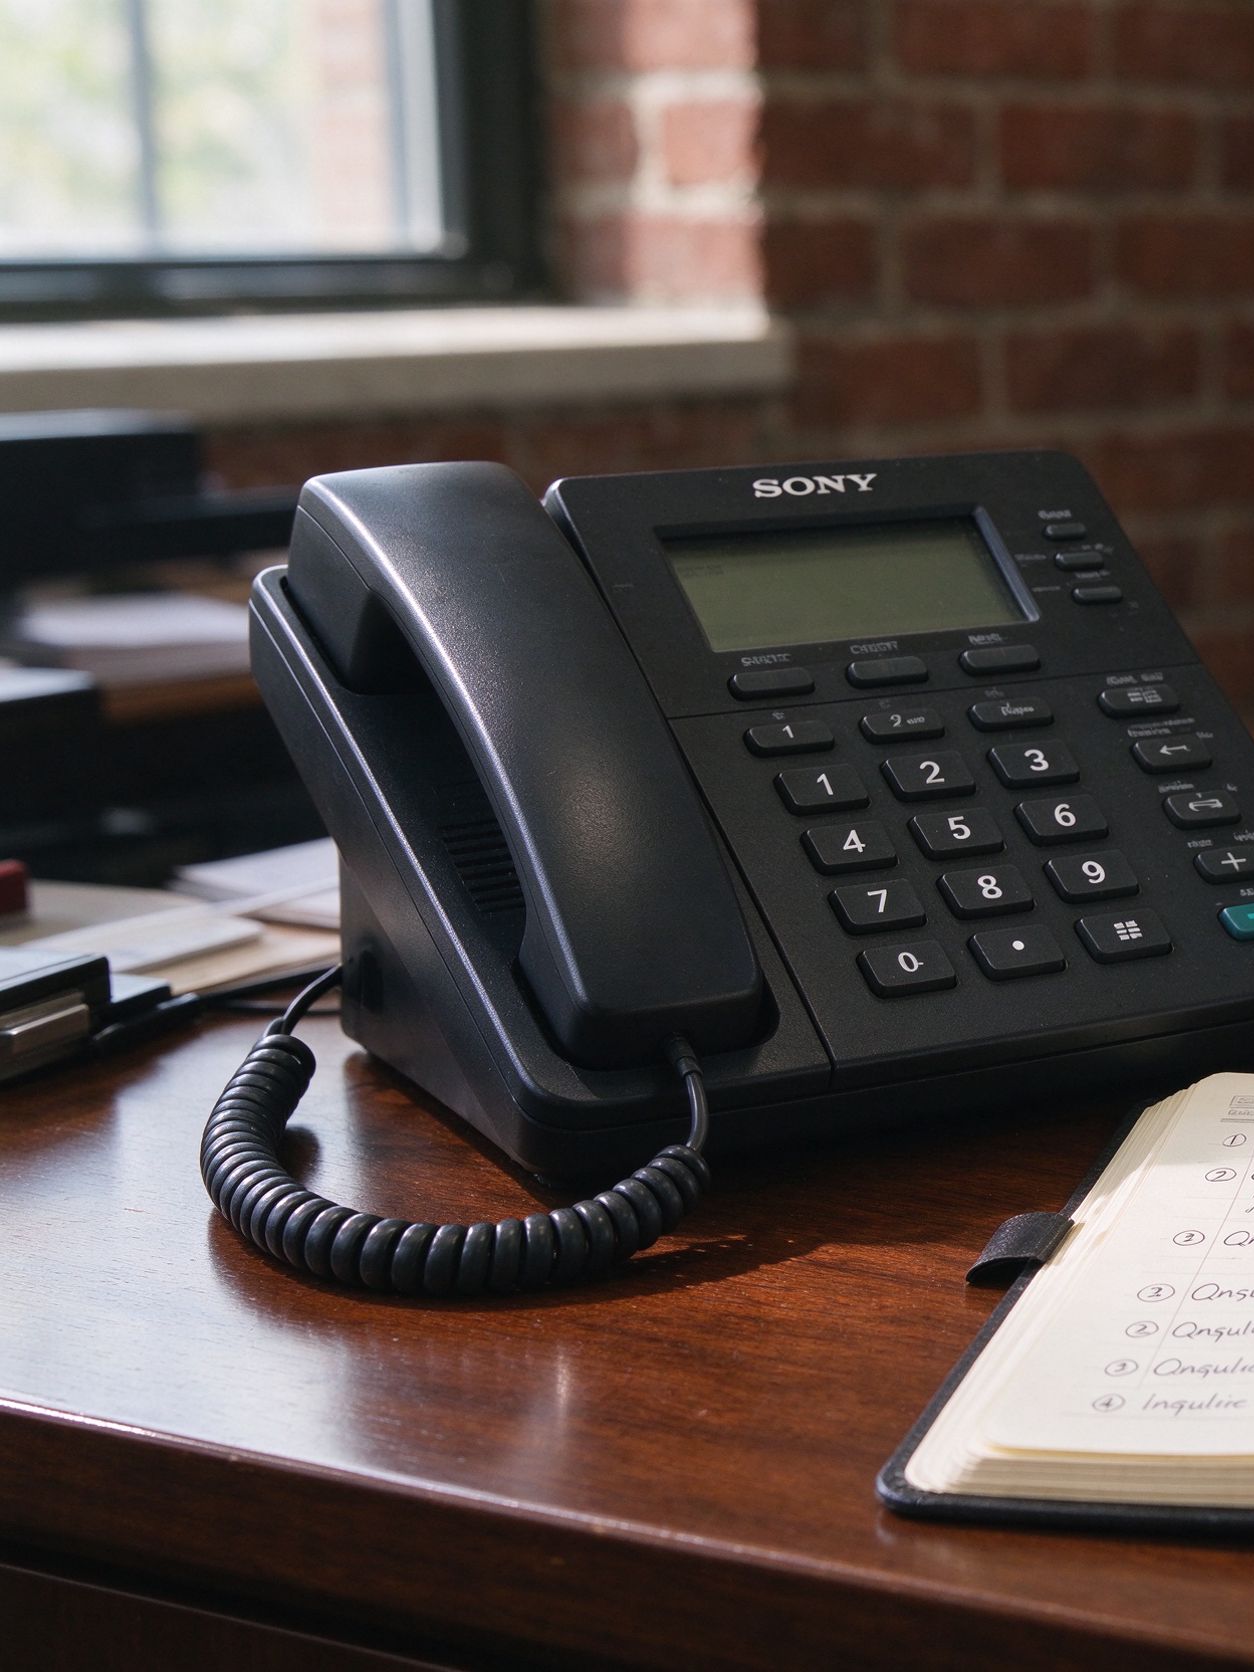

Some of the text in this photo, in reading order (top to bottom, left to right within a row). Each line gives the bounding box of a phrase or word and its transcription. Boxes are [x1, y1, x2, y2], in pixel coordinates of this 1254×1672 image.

[752, 472, 878, 499] SONY
[816, 748, 1050, 796] 1 2 3
[842, 803, 1077, 854] 4 5 6
[867, 859, 1107, 914] 7 8 9
